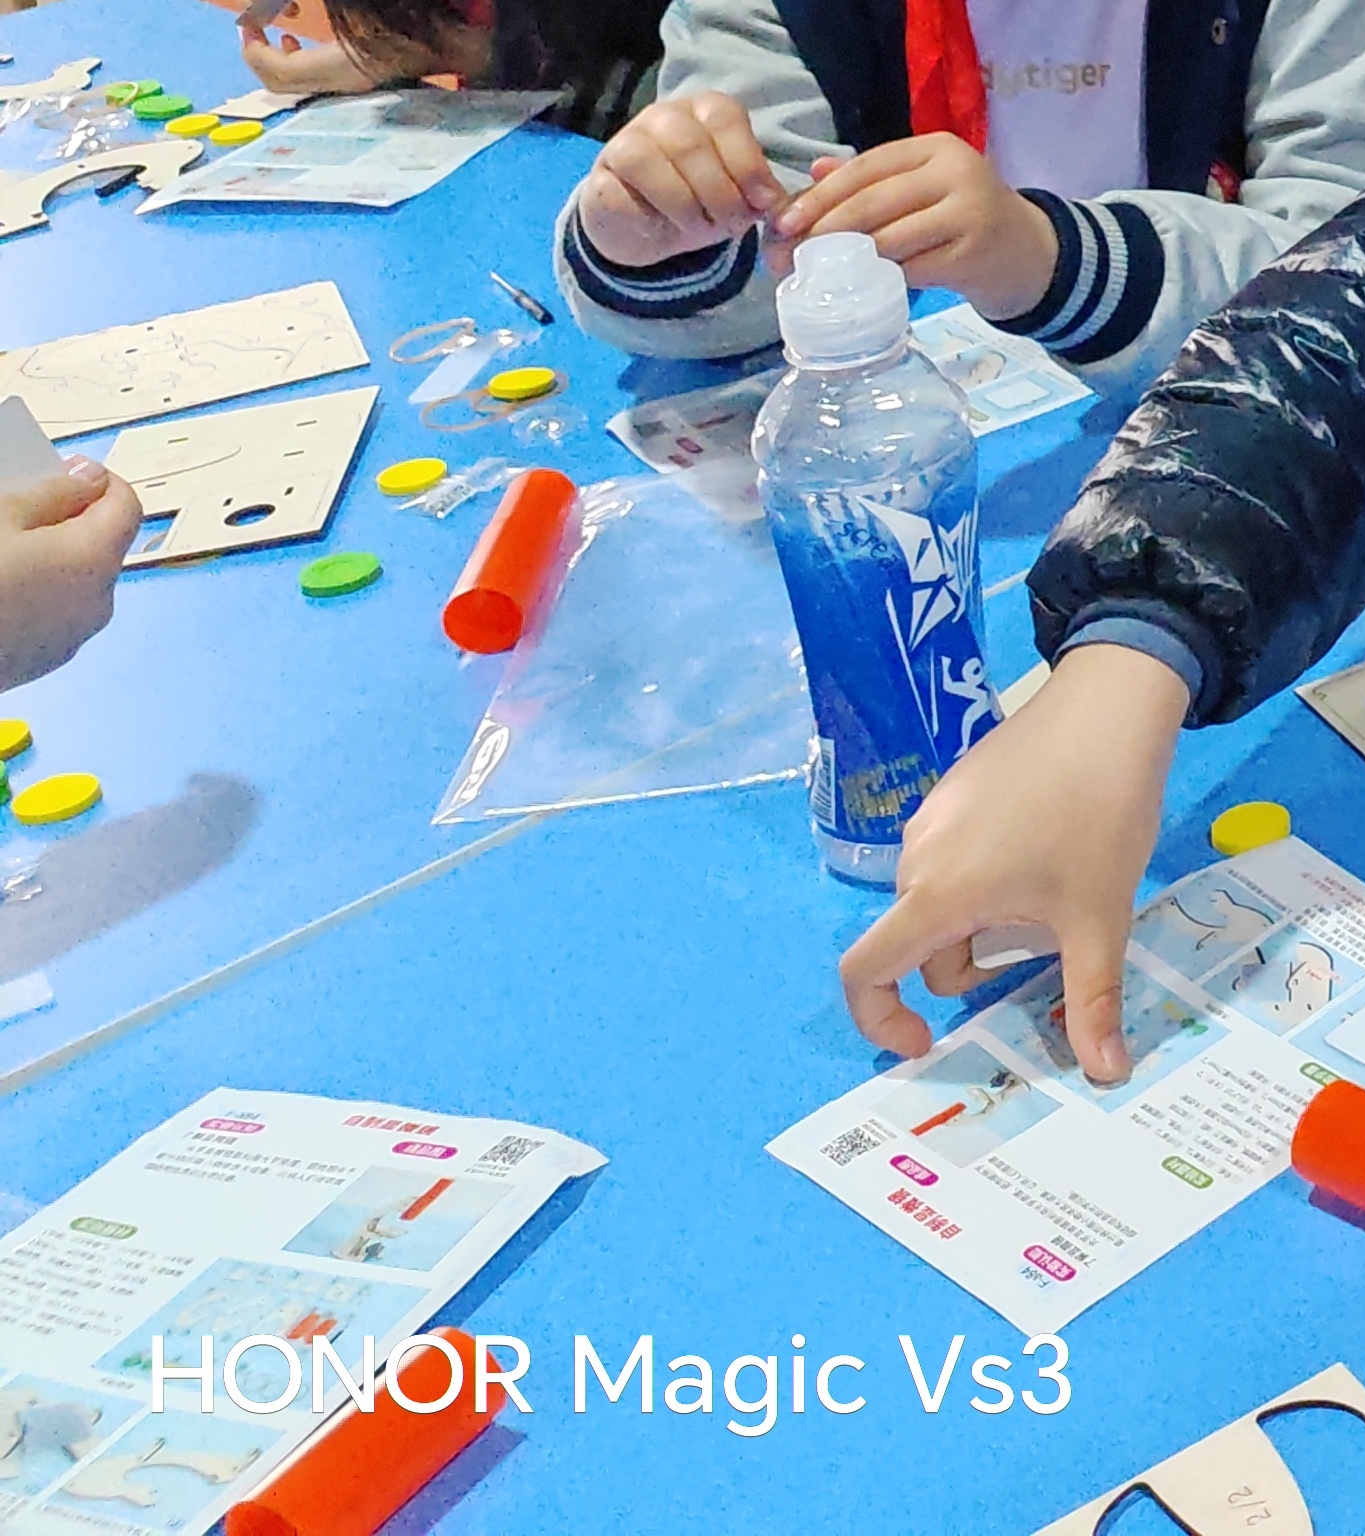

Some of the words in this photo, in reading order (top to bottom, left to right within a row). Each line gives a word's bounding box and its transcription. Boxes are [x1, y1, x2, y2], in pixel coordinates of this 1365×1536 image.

[886, 1187, 964, 1240] 自制显微镜
[1228, 1485, 1272, 1527] 2/2
